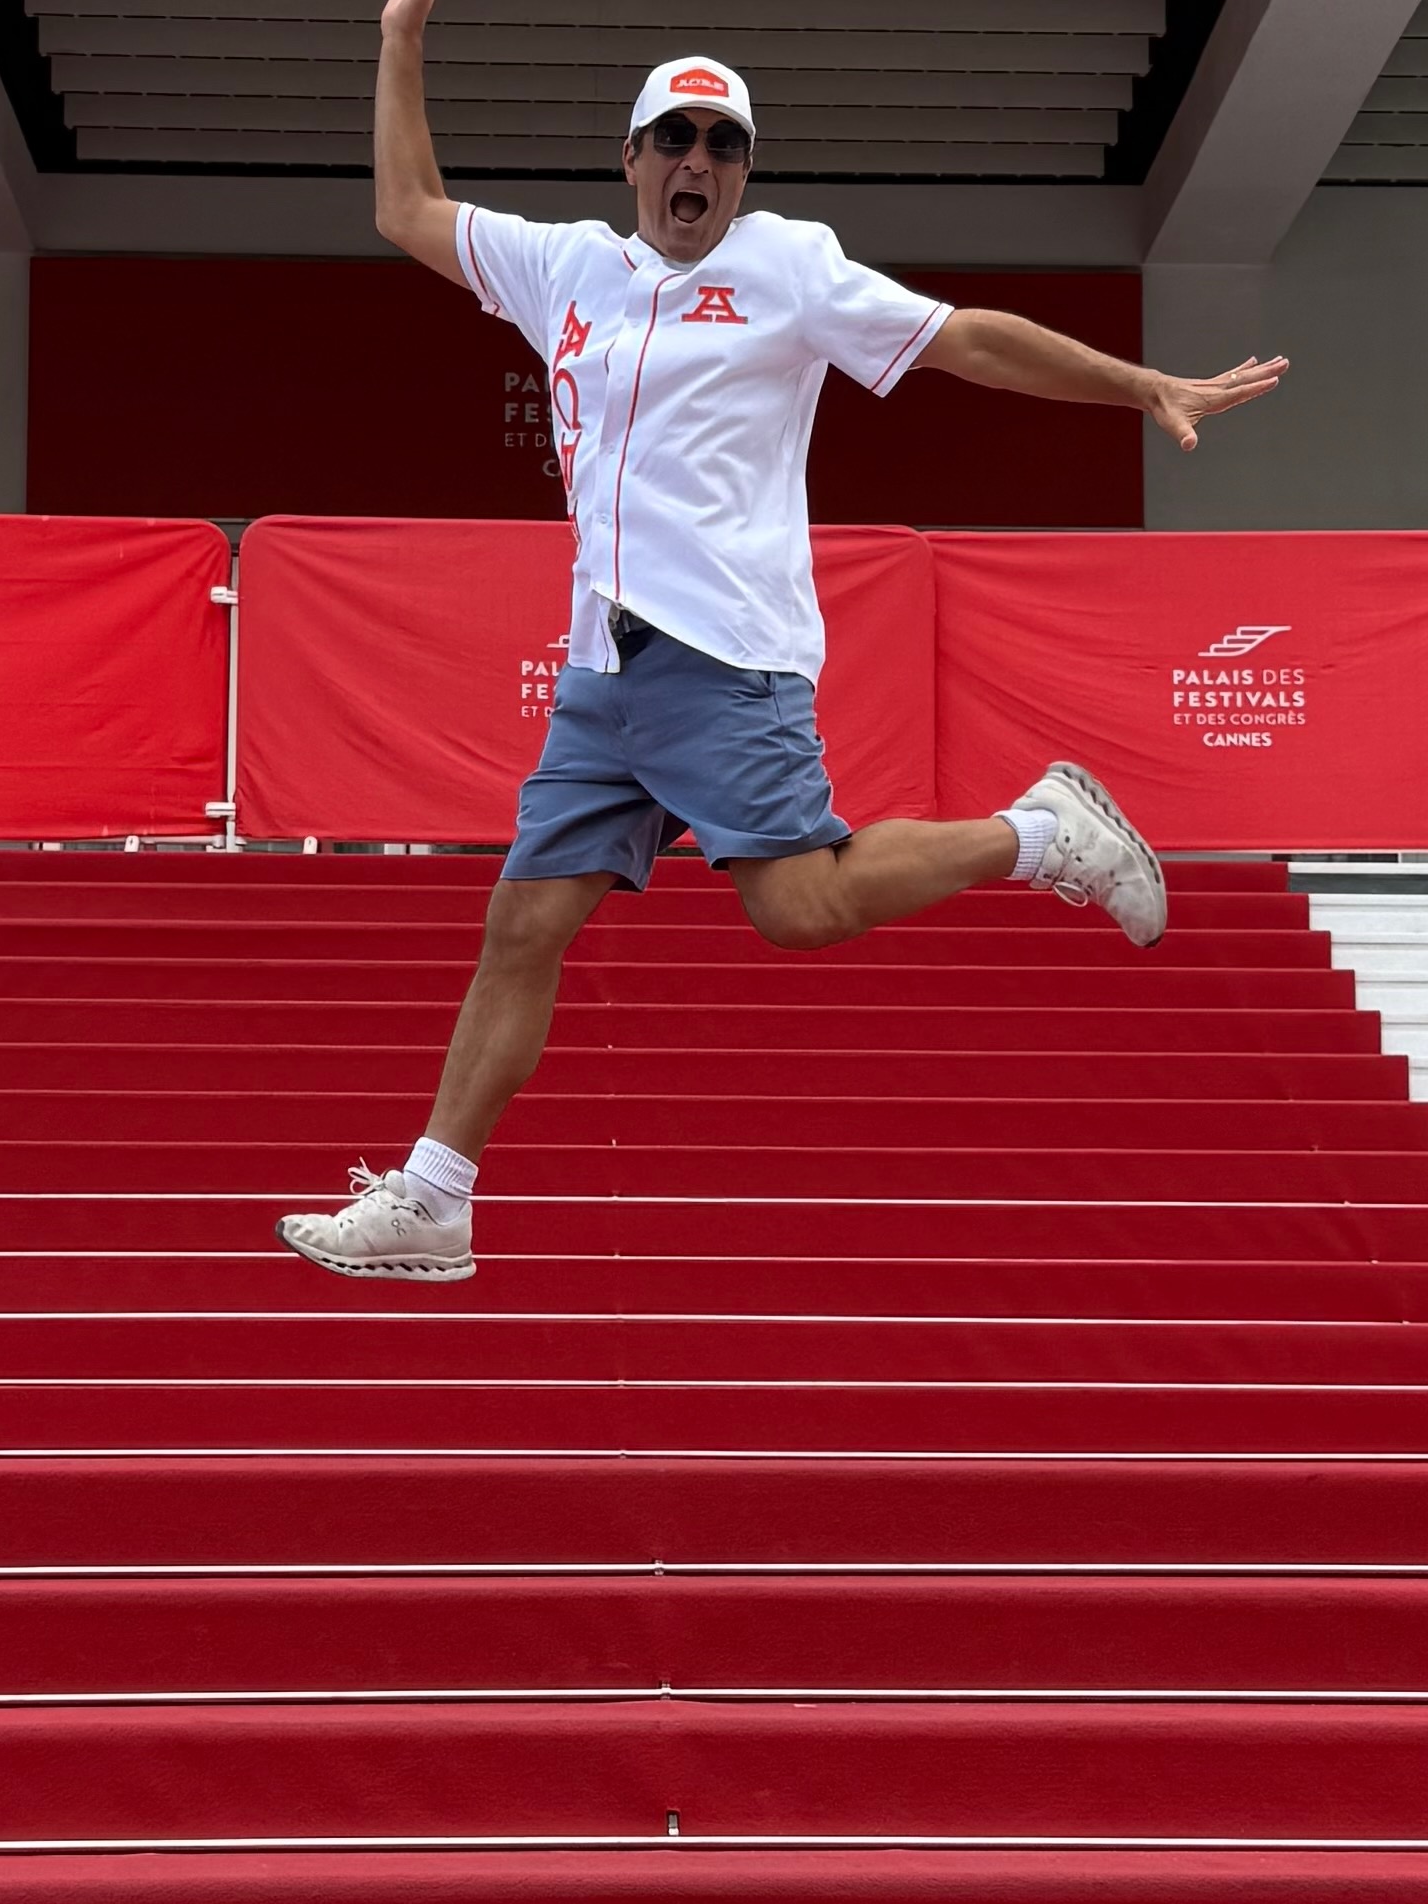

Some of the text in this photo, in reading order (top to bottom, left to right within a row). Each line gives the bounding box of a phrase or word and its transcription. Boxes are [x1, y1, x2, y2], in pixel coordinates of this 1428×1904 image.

[681, 286, 748, 324] A
[521, 660, 560, 676] PAL
[1172, 668, 1305, 685] PALAIS DES
[1172, 691, 1306, 708] FESTIVALS
[521, 705, 538, 718] ET
[1173, 709, 1306, 726] ET DES CONGRÈS
[1202, 732, 1272, 747] CANNES
